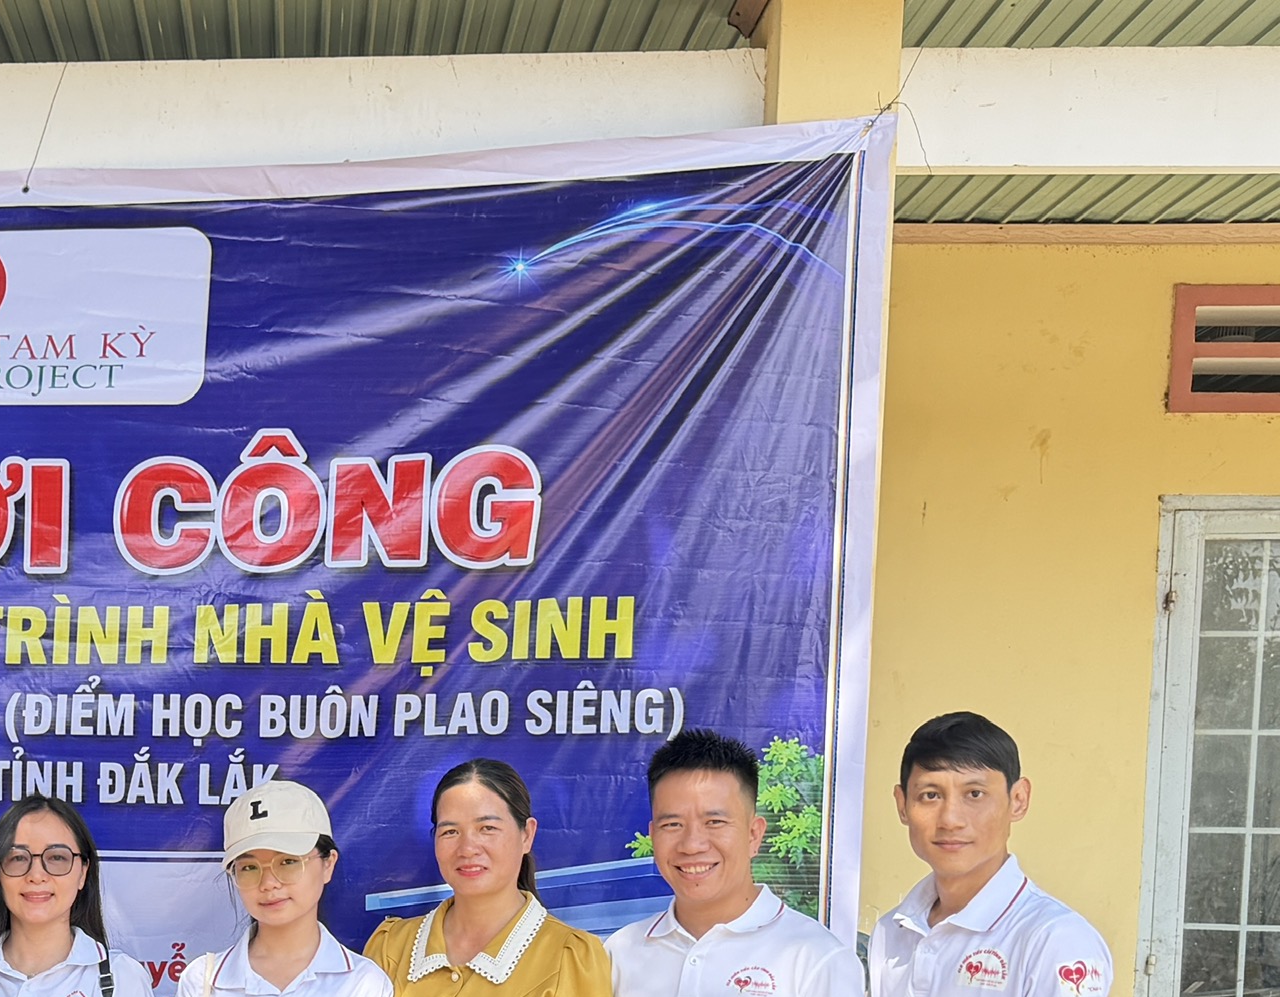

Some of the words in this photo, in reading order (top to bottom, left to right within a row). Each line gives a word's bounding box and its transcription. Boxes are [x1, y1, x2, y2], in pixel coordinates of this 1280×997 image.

[99, 325, 157, 359] KỲ
[114, 428, 541, 574] CÔNG
[192, 590, 340, 665] NHÀ
[362, 589, 451, 676] VỆ
[469, 596, 635, 660] SINH
[4, 675, 135, 743] (ĐIỂM
[151, 693, 242, 746] HỌC
[259, 685, 379, 738] BUÔN
[393, 690, 509, 736] PLAO
[525, 680, 684, 741] SIÊNG)
[97, 746, 184, 804] ĐẮK
[249, 800, 269, 821] L
